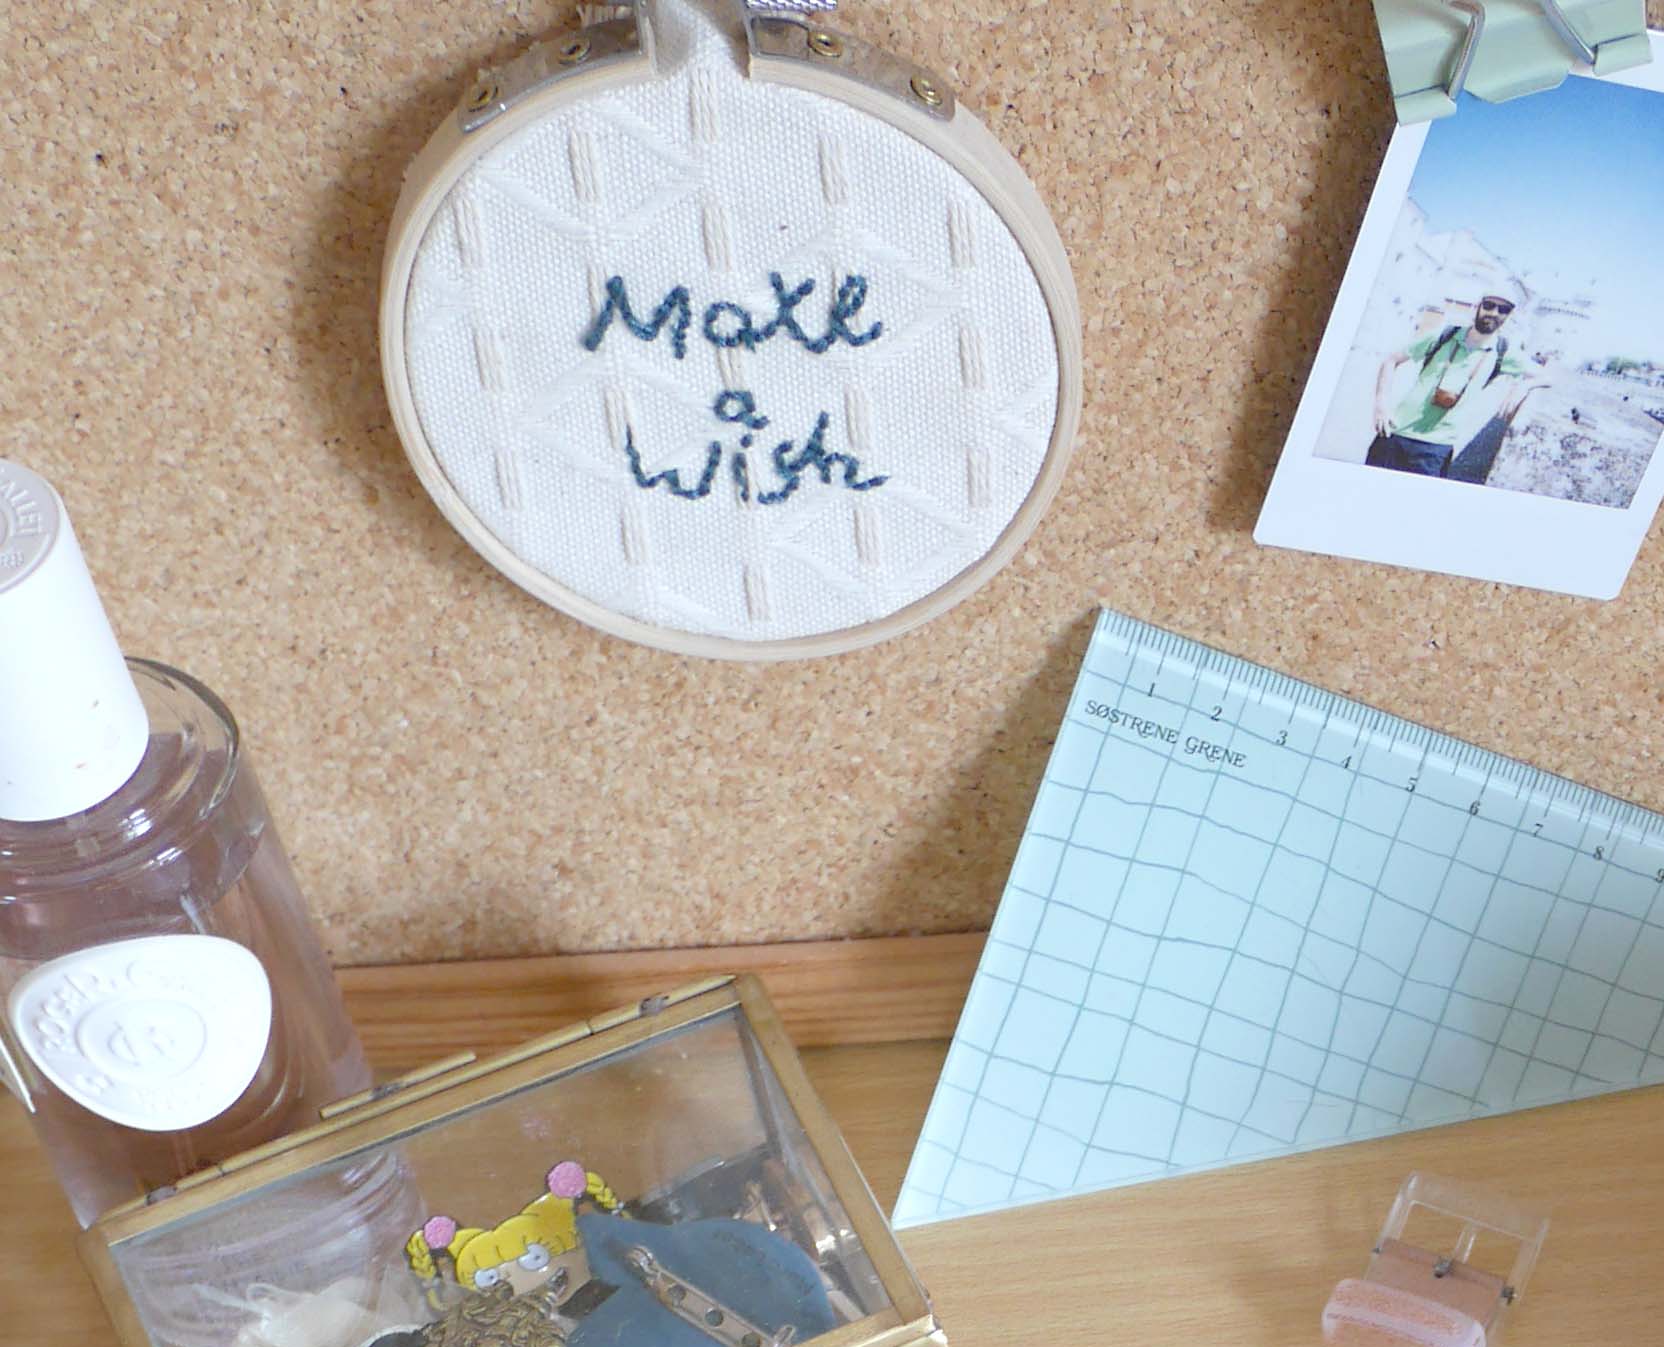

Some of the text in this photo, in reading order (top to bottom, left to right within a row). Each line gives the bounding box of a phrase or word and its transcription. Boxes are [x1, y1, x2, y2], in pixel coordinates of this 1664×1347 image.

[580, 271, 883, 359] Make
[713, 389, 768, 430] a
[1084, 699, 1246, 769] SØSTRENE GRENE
[1146, 682, 1157, 698] 1
[1209, 706, 1223, 722] 2
[1275, 730, 1289, 746] 3
[1340, 754, 1353, 770] 4
[1405, 777, 1418, 793] 5
[1468, 800, 1481, 817] 6
[1532, 823, 1545, 838] 7
[1593, 845, 1604, 861] 8
